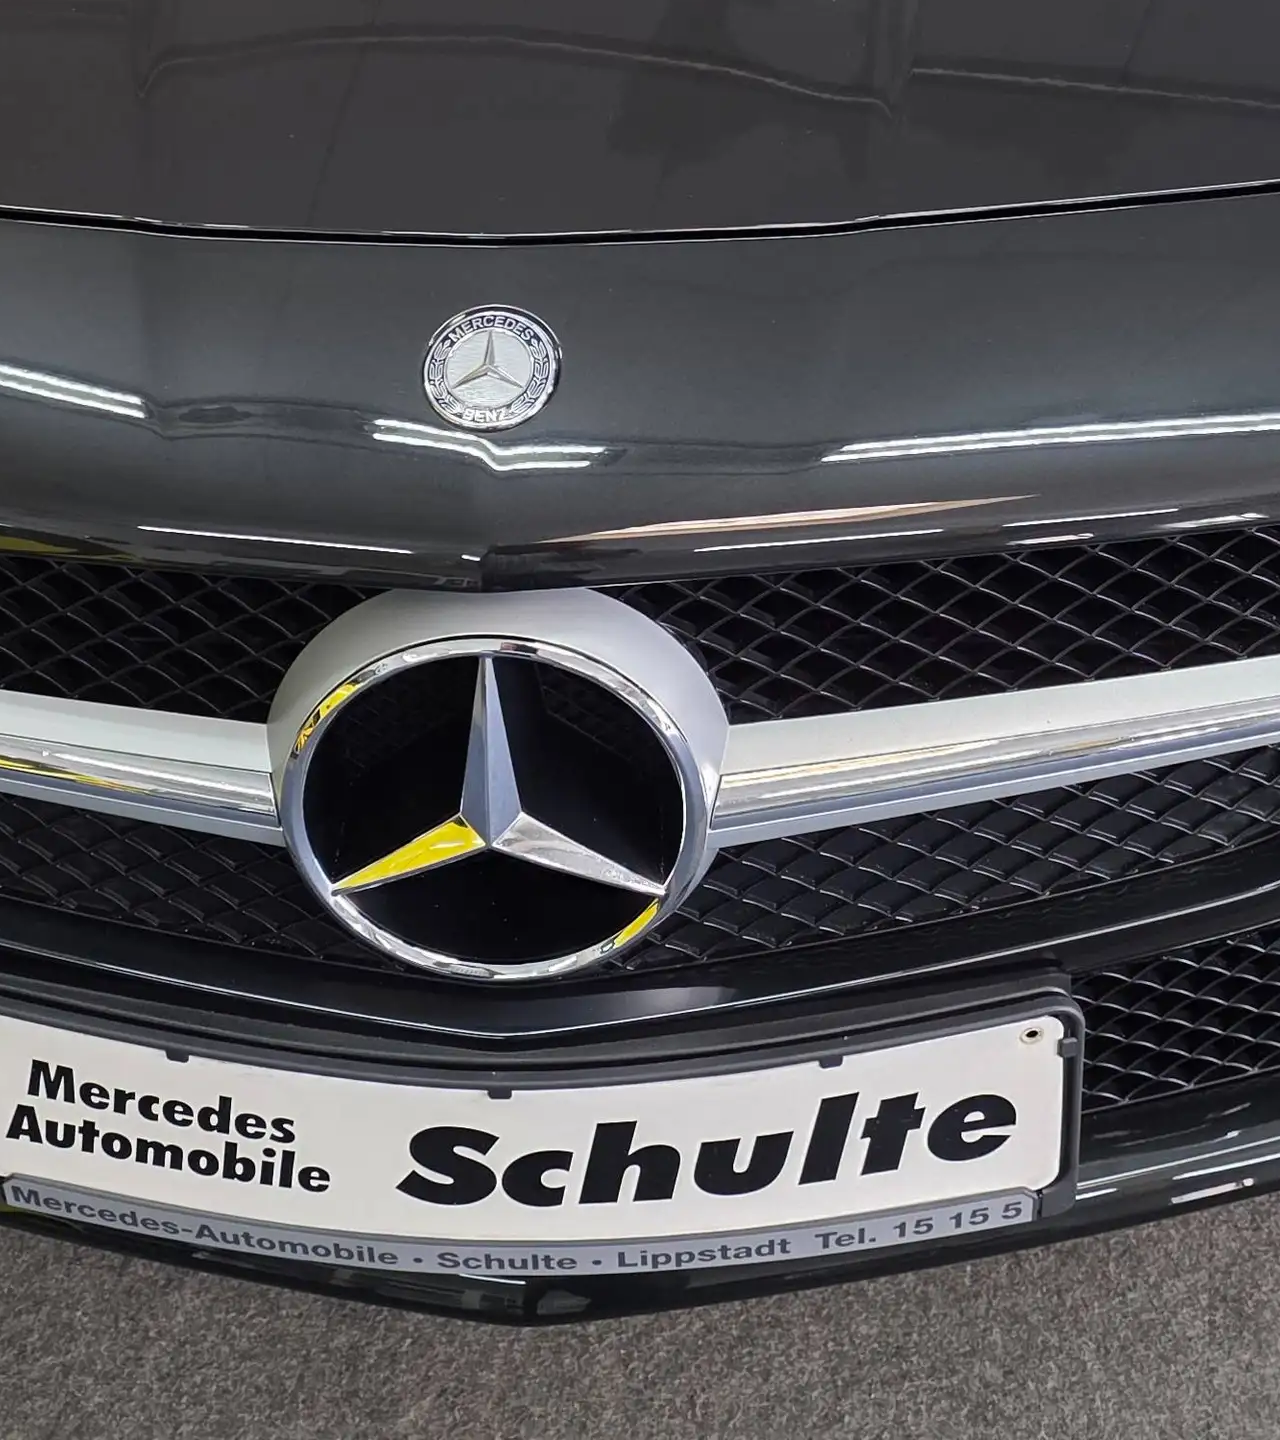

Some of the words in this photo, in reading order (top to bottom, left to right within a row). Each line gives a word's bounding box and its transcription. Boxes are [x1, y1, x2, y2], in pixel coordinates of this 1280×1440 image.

[450, 315, 534, 343] MERCEDES
[462, 409, 511, 423] BENZ
[27, 1059, 296, 1144] Mercedes
[5, 1103, 331, 1194] Automobile
[395, 1090, 1017, 1206] Schulte
[11, 1184, 398, 1266] Mercedes-Automobile
[437, 1251, 577, 1270] Schulte
[617, 1238, 791, 1269] Lippstadt
[814, 1228, 877, 1252] Tel.
[892, 1217, 934, 1239] 15
[947, 1207, 989, 1230] 15
[1001, 1201, 1022, 1220] 5
